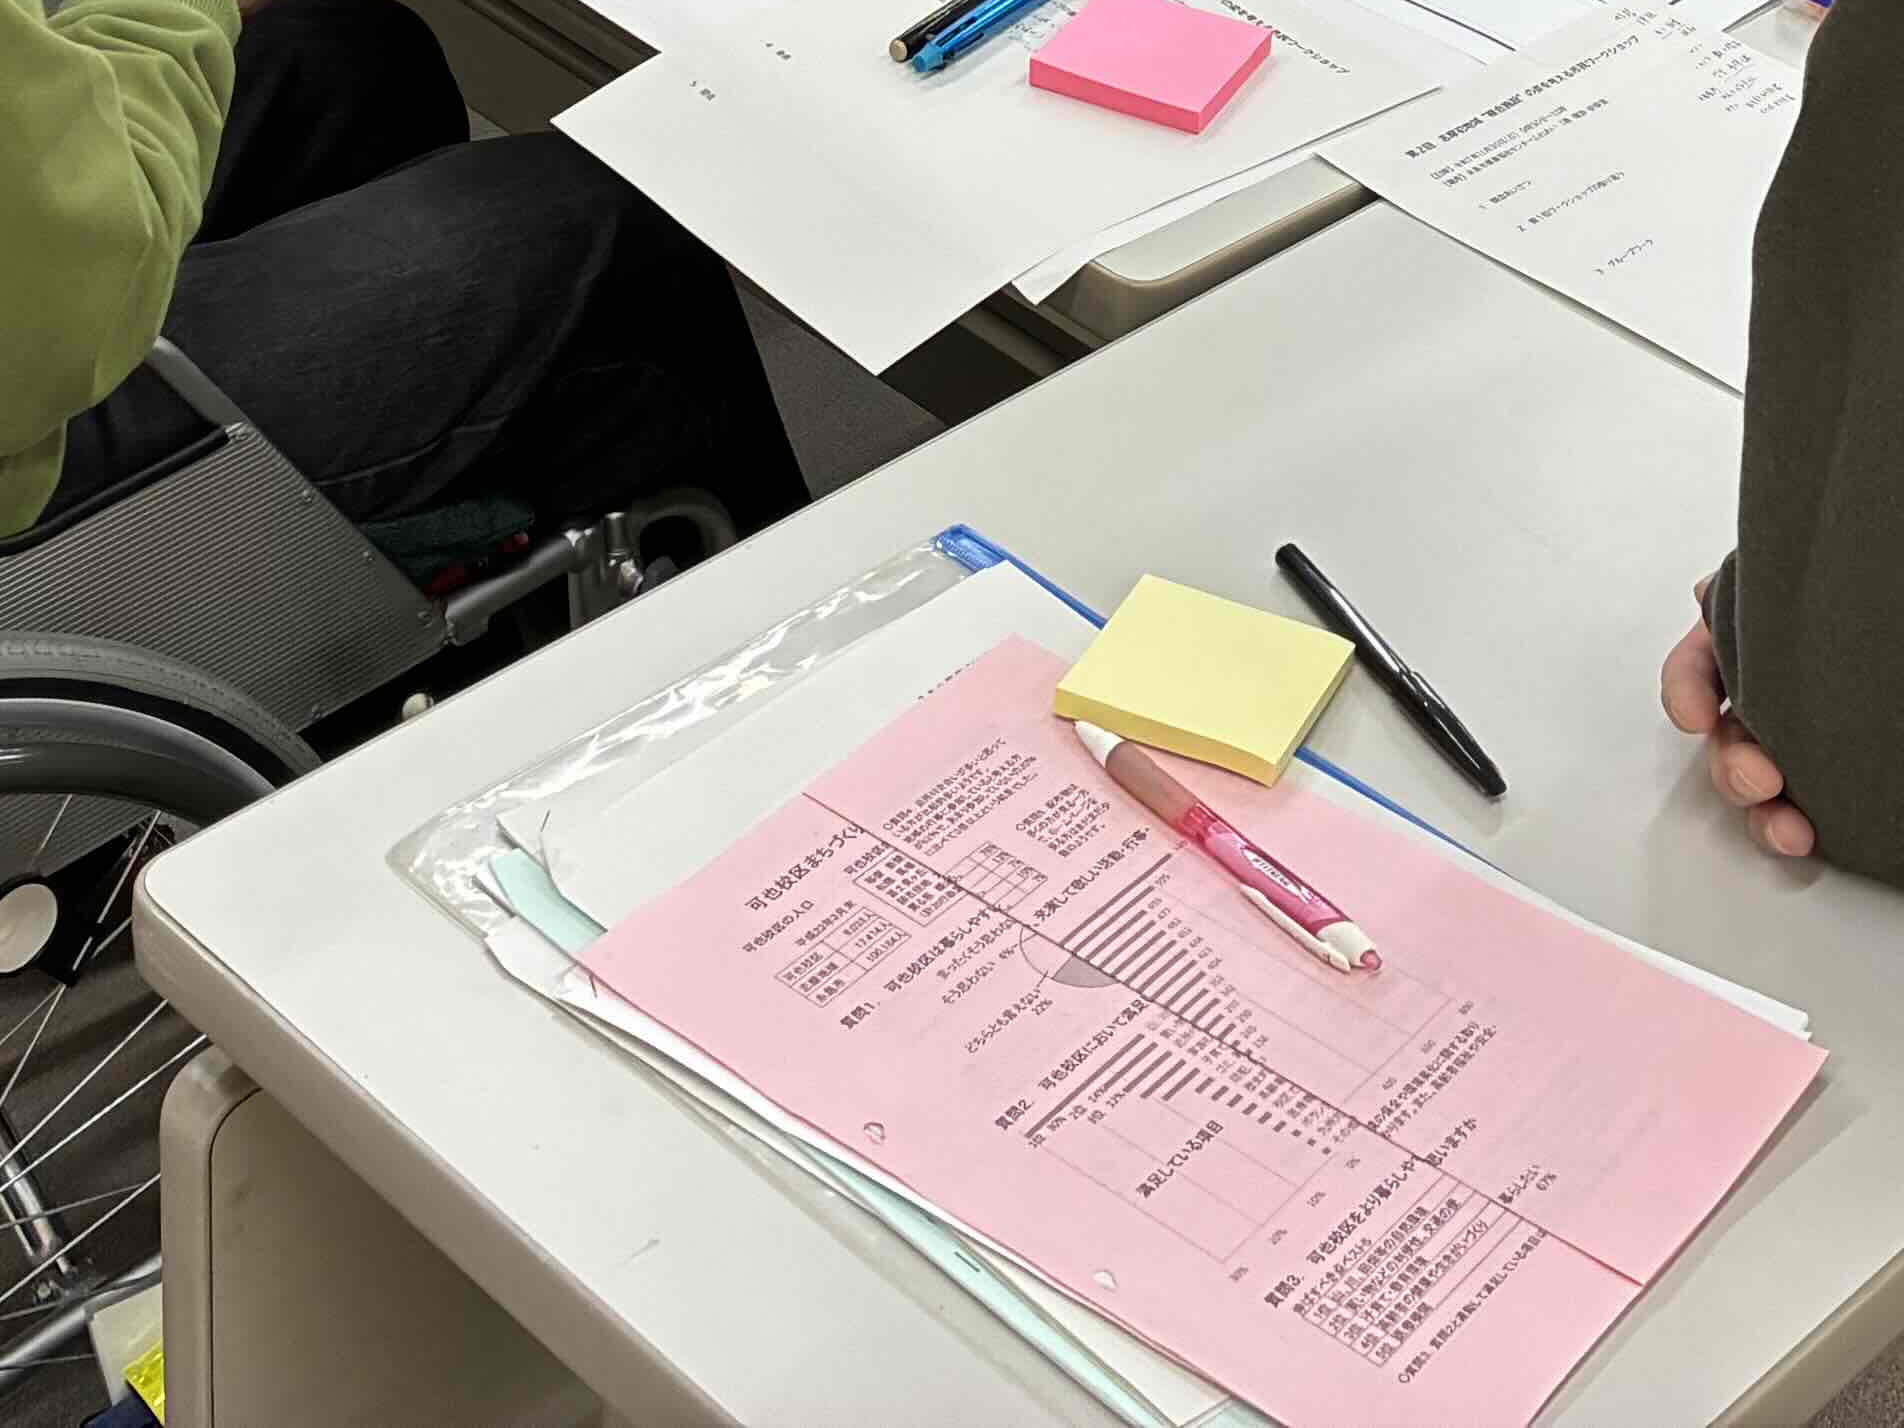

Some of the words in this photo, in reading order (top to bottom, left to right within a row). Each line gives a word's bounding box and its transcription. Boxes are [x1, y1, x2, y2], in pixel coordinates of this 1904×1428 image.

[1134, 1116, 1225, 1199] 満足している項目
